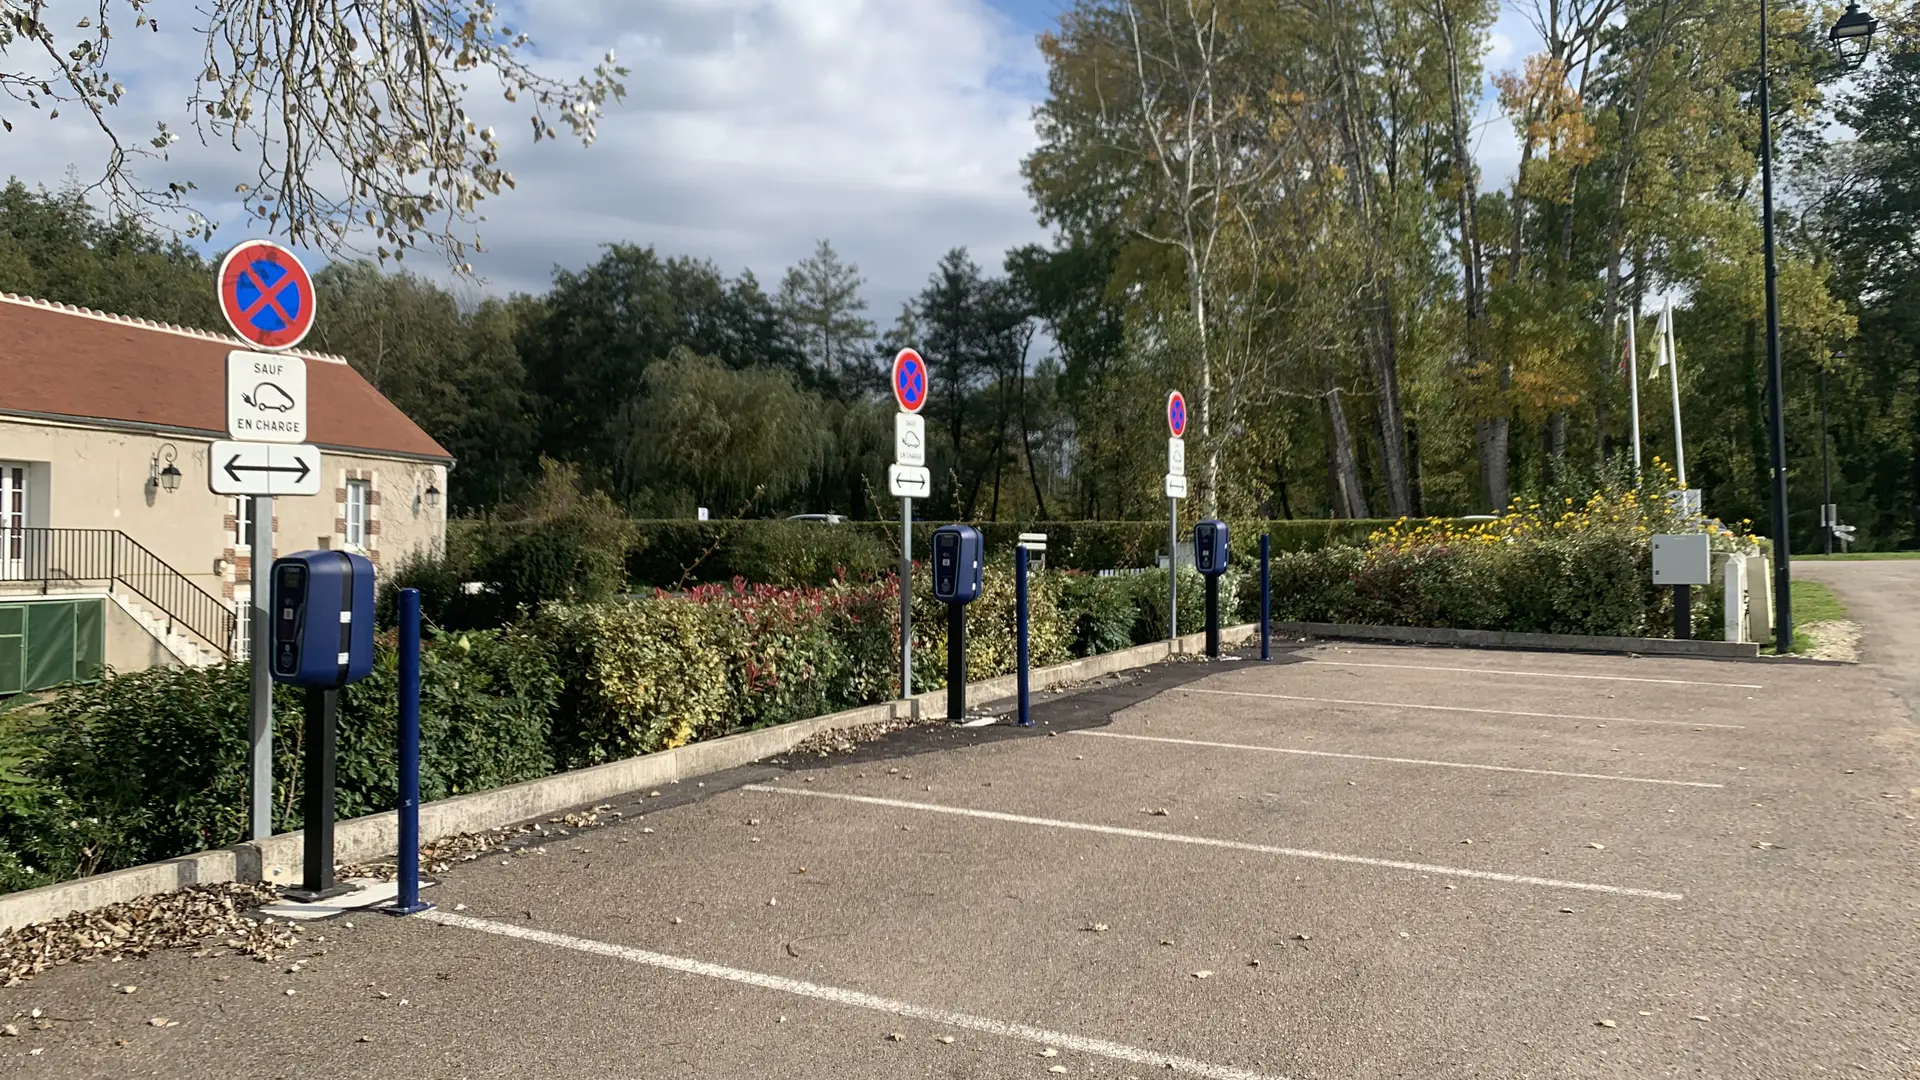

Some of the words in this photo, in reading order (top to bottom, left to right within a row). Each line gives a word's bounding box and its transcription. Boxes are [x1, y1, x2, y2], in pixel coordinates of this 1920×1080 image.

[254, 363, 283, 375] SAUF
[238, 418, 252, 430] EN
[256, 420, 300, 432] CHARGE
